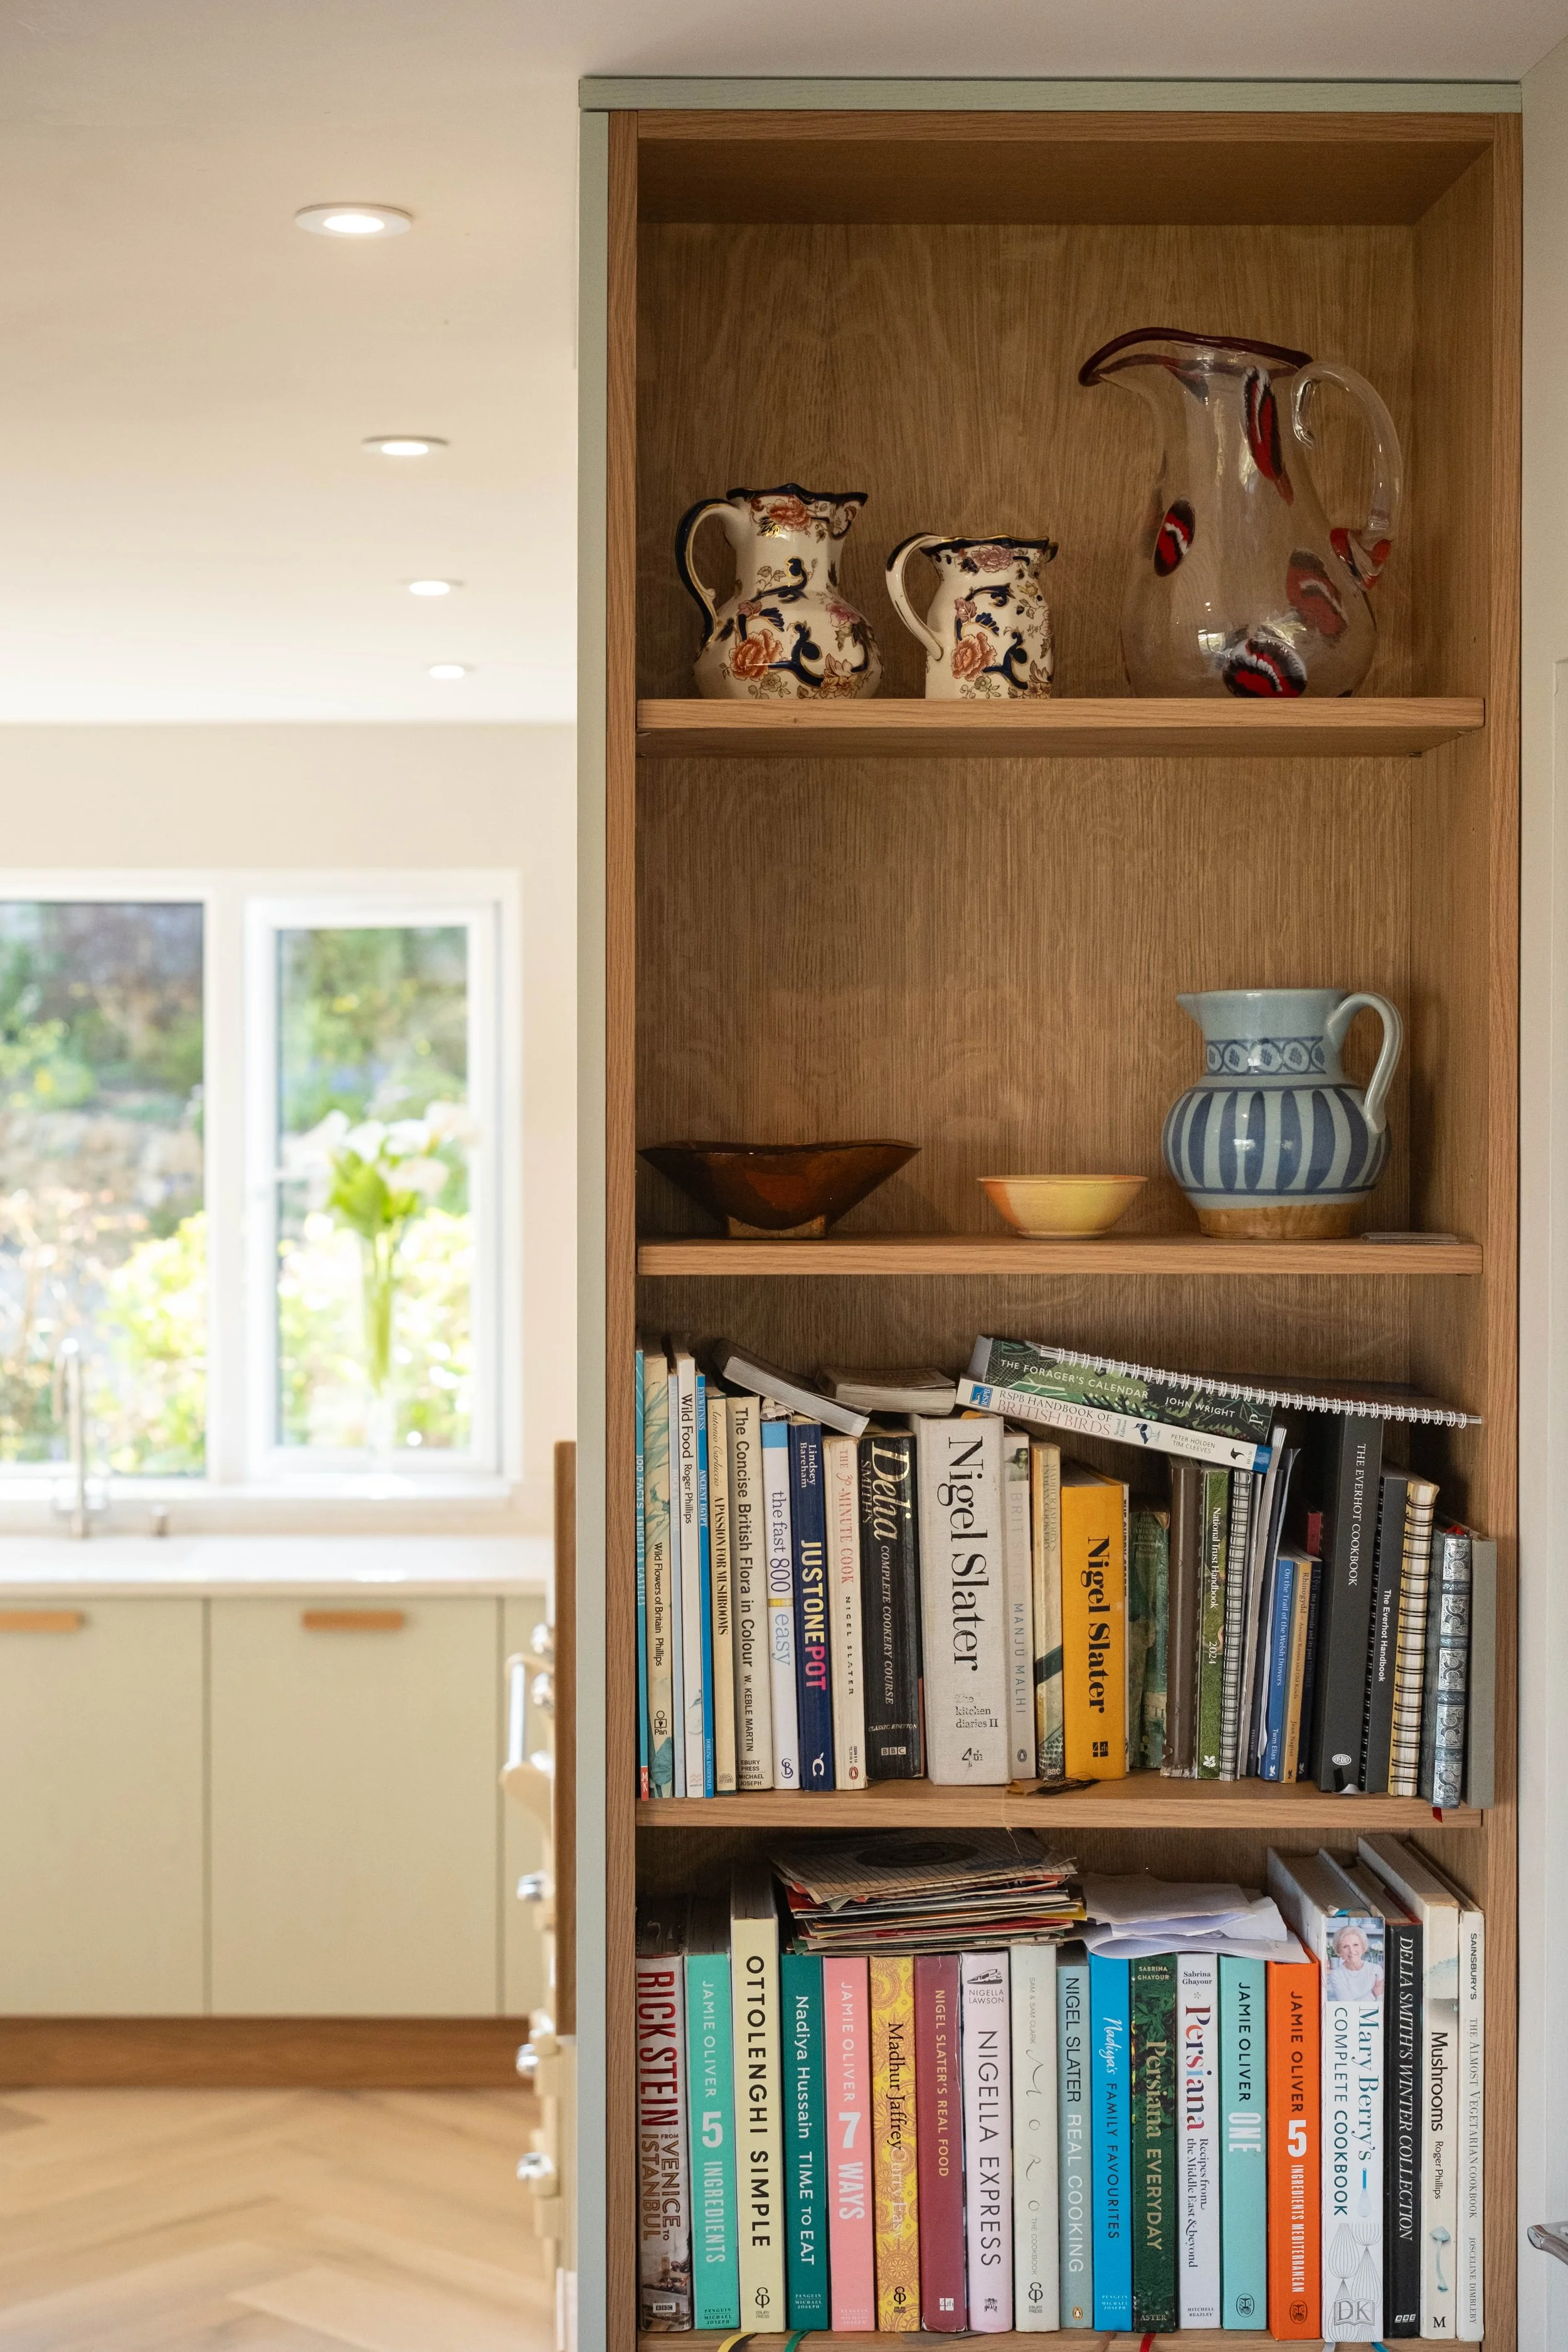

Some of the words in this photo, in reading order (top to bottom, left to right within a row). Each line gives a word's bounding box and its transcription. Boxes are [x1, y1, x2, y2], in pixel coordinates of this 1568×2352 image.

[681, 1394, 692, 1421] Wild
[1000, 1391, 1025, 1402] RSPB
[1028, 1396, 1093, 1418] HANDBOOK
[1098, 1413, 1113, 1422] OF
[1001, 1360, 1022, 1372] THE
[1025, 1364, 1086, 1387] FORAGER'S
[1088, 1377, 1148, 1399] CALENDAR
[1166, 1396, 1191, 1410] JOHN
[1194, 1401, 1236, 1417] WRIGHT
[682, 1426, 693, 1458] Food
[712, 1405, 721, 1443] Antonio
[736, 1407, 748, 1434] The
[998, 1401, 1060, 1424] BRITISH
[1064, 1414, 1111, 1436] BIRDS
[1191, 1438, 1215, 1448] HOLDEN
[712, 1446, 723, 1486] Carluccio
[737, 1441, 750, 1497] Concise
[800, 1442, 808, 1488] Bareham
[807, 1444, 817, 1485] Lindsey
[1186, 1443, 1211, 1453] CLEEVES
[1356, 1444, 1366, 1466] THE
[683, 1465, 692, 1490] Roger
[861, 1460, 872, 1523] SMITH'S
[872, 1441, 911, 1540] Delia
[938, 1436, 987, 1540] Nigel
[1352, 1469, 1364, 1521] EVERHOT
[683, 1493, 692, 1523] Phillips
[715, 1504, 726, 1545] PASSION
[738, 1504, 752, 1550] British
[772, 1491, 786, 1517] the
[1211, 1507, 1221, 1542] National
[654, 1543, 663, 1561] Wild
[716, 1548, 726, 1568] FOR
[773, 1522, 787, 1553] fast
[1210, 1544, 1221, 1564] Trust
[1348, 1523, 1361, 1586] COOKBOOK
[655, 1563, 663, 1595] Flowers
[740, 1557, 753, 1594] Flora
[770, 1558, 790, 1592] 800
[880, 1545, 891, 1602] COMPLETE
[1081, 1535, 1110, 1614] Nigel
[1210, 1566, 1219, 1608] Handbook
[1284, 1569, 1291, 1579] On
[1382, 1589, 1391, 1604] The
[655, 1597, 663, 1606] of
[655, 1607, 663, 1633] Britain
[716, 1571, 728, 1635] MUSHROOMS
[741, 1600, 754, 1613] in
[951, 1553, 989, 1671] Slater
[1380, 1606, 1391, 1638] Everhot
[655, 1638, 664, 1666] Phillips
[742, 1619, 755, 1667] Colour
[772, 1614, 791, 1665] easy
[883, 1606, 893, 1658] COOKERY
[1209, 1641, 1217, 1664] 2024
[1278, 1635, 1286, 1656] Welsh
[744, 1675, 751, 1685] W.
[884, 1661, 893, 1704] COURSE
[1088, 1623, 1111, 1713] Slater
[1277, 1658, 1285, 1686] Drovers
[1378, 1640, 1389, 1682] Handbook
[744, 1688, 753, 1715] KEBLE
[1399, 1937, 1414, 1988] DELIA
[637, 1971, 676, 2040] RICK
[702, 1981, 715, 2030] JAMIE
[796, 1996, 810, 2060] Nadiya
[840, 1982, 854, 2033] JAMIE
[936, 1990, 946, 2030] NIGEL
[1065, 1978, 1081, 2030] NIGEL
[1239, 1982, 1251, 2033] JAMIE
[1290, 1991, 1303, 2043] JAMIE
[1399, 1992, 1413, 2059] SMITH'S
[1470, 2019, 1478, 2038] THE
[746, 1956, 768, 2133] OTTOLENGHI
[887, 2023, 903, 2091] Madhur
[936, 2034, 948, 2095] SLATER'S
[1098, 2017, 1123, 2074] Nadiya's
[1333, 2007, 1347, 2102] COMPLETE
[1352, 2006, 1379, 2072] Mary
[1469, 2042, 1481, 2086] ALMOST
[640, 2047, 679, 2126] STEIN
[704, 2036, 716, 2097] OLIVER
[842, 2038, 855, 2101] OLIVER
[978, 2031, 1000, 2143] NIGELLA
[1066, 2037, 1081, 2102] SLATER
[1146, 2040, 1167, 2139] Persiana
[1185, 2006, 1212, 2131] Persiana
[1239, 2038, 1251, 2102] OLIVER
[1290, 2052, 1303, 2112] OLIVER
[1431, 2032, 1448, 2131] Mushrooms
[798, 2067, 812, 2138] Hussain
[886, 2094, 906, 2151] Jaffrey
[937, 2100, 949, 2134] REAL
[1106, 2083, 1118, 2137] FAMILY
[1349, 2075, 1380, 2161] Berry's
[1399, 2064, 1412, 2131] WINTER
[702, 2111, 723, 2148] 5
[839, 2112, 862, 2148] 7
[1067, 2114, 1082, 2166] REAL
[1228, 2112, 1261, 2153] ONE
[1288, 2121, 1307, 2157] 5
[1469, 2091, 1481, 2164] VEGETARIAN
[799, 2152, 813, 2199] TIME
[938, 2139, 950, 2176] FOOD
[1333, 2110, 1348, 2216] COOKBOOK
[1433, 2141, 1443, 2166] Roger
[641, 2134, 660, 2240] ISTANBUL
[662, 2140, 681, 2227] VENICE
[750, 2151, 770, 2247] SIMPLE
[839, 2162, 865, 2219] WAYS
[1106, 2144, 1119, 2239] FAVOURITES
[1147, 2148, 1162, 2251] EVERYDAY
[1291, 2164, 1305, 2220] INGREDIENTS
[1399, 2136, 1412, 2240] COLLECTION
[1433, 2169, 1443, 2199] Phillips
[1469, 2166, 1477, 2219] COOKBOOK
[662, 2230, 669, 2240] TO
[704, 2161, 725, 2263] INGREDIENTS
[801, 2206, 812, 2225] TO
[980, 2156, 1001, 2266] EXPRESS
[1068, 2175, 1083, 2272] COOKING
[801, 2230, 815, 2265] EAT
[1291, 2224, 1305, 2292] MEDITERRANEAN
